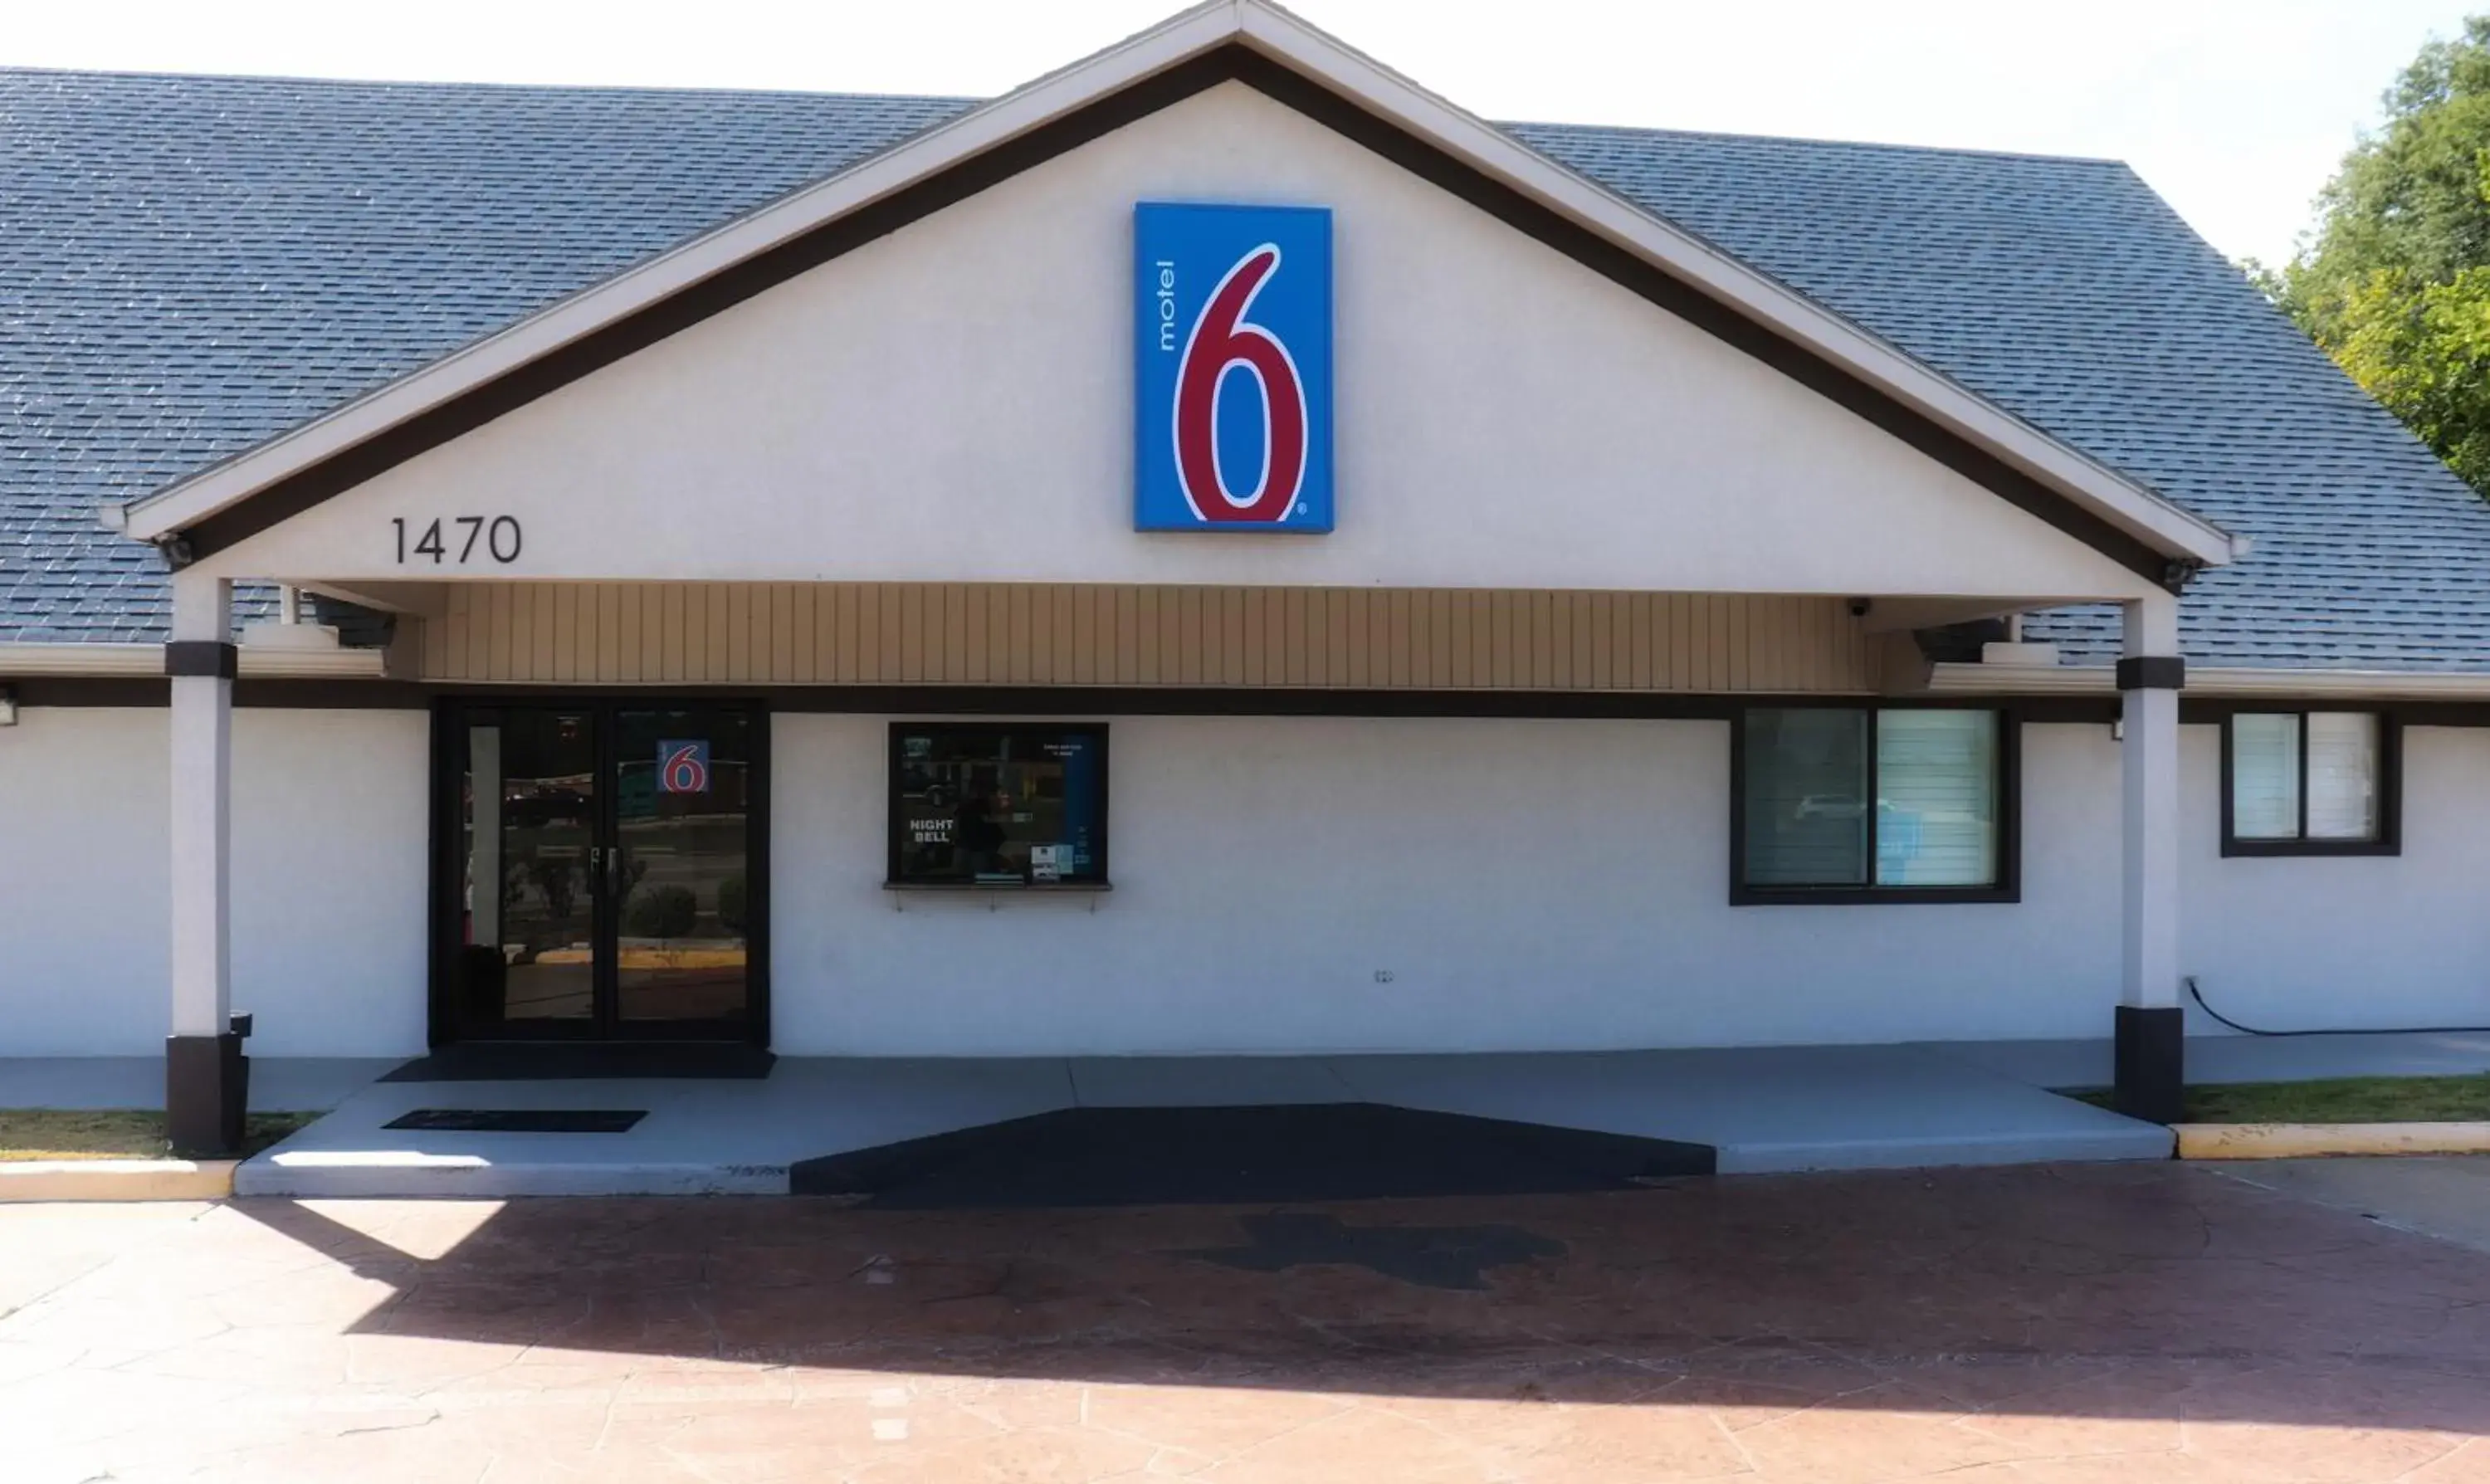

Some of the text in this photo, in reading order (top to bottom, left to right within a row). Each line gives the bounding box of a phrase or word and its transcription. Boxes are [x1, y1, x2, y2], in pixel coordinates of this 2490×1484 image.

[1156, 261, 1175, 351] motel
[1172, 242, 1309, 522] 6
[391, 515, 522, 564] 1470
[663, 744, 705, 793] 6
[910, 819, 954, 831] NIGHT
